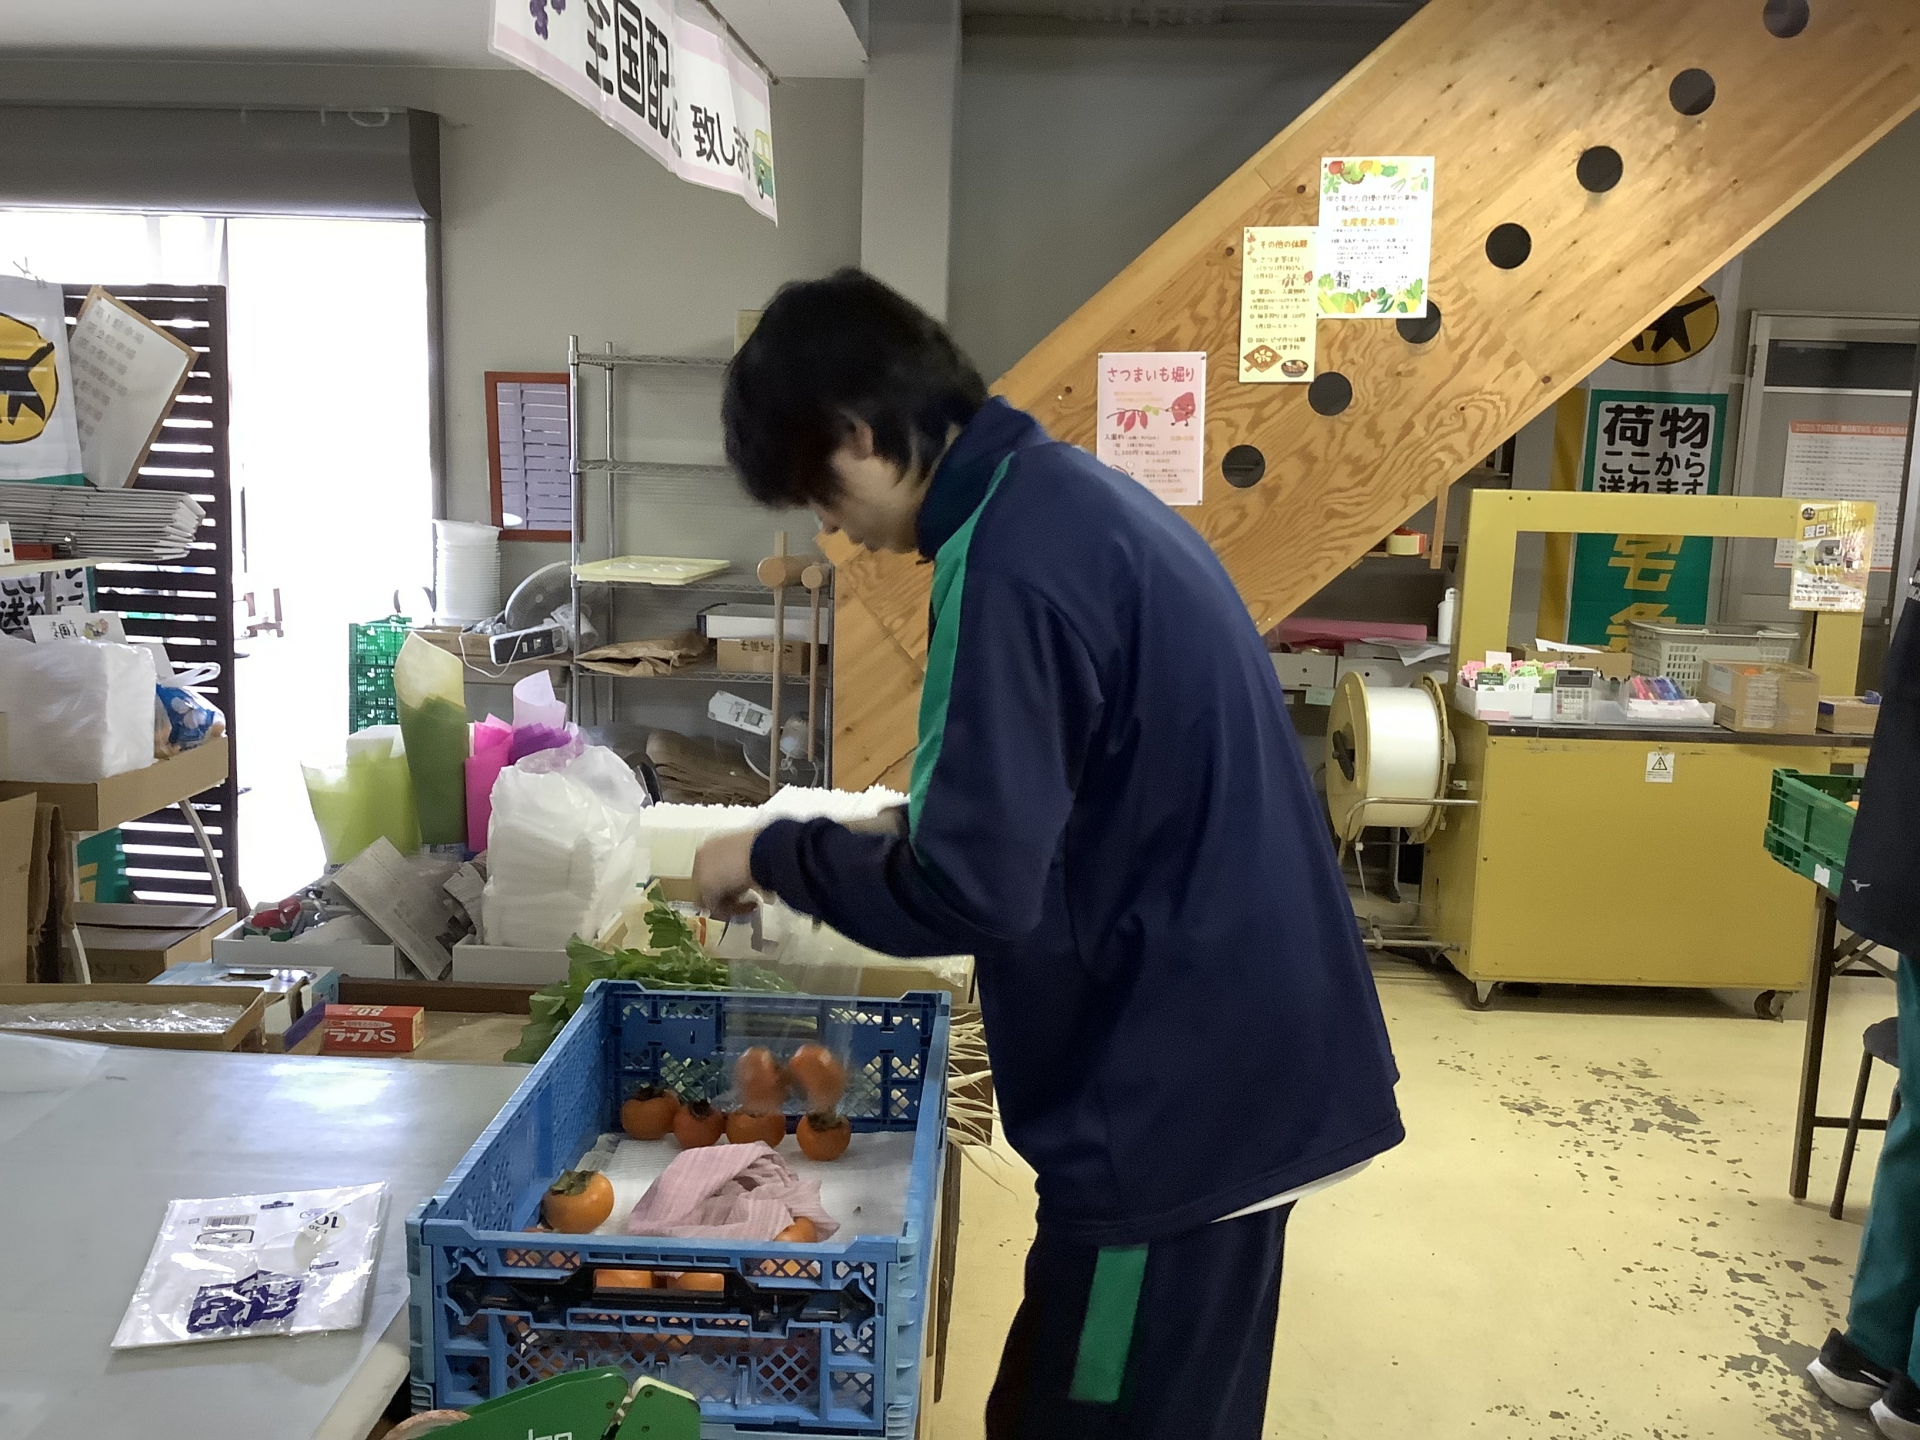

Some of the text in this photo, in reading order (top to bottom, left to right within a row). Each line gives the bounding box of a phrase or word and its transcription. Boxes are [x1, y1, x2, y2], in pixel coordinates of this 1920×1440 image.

[586, 0, 681, 158] 全国配
[1260, 239, 1308, 249] その他の体験
[1602, 404, 1711, 450] 荷物
[1602, 451, 1705, 478] ここから
